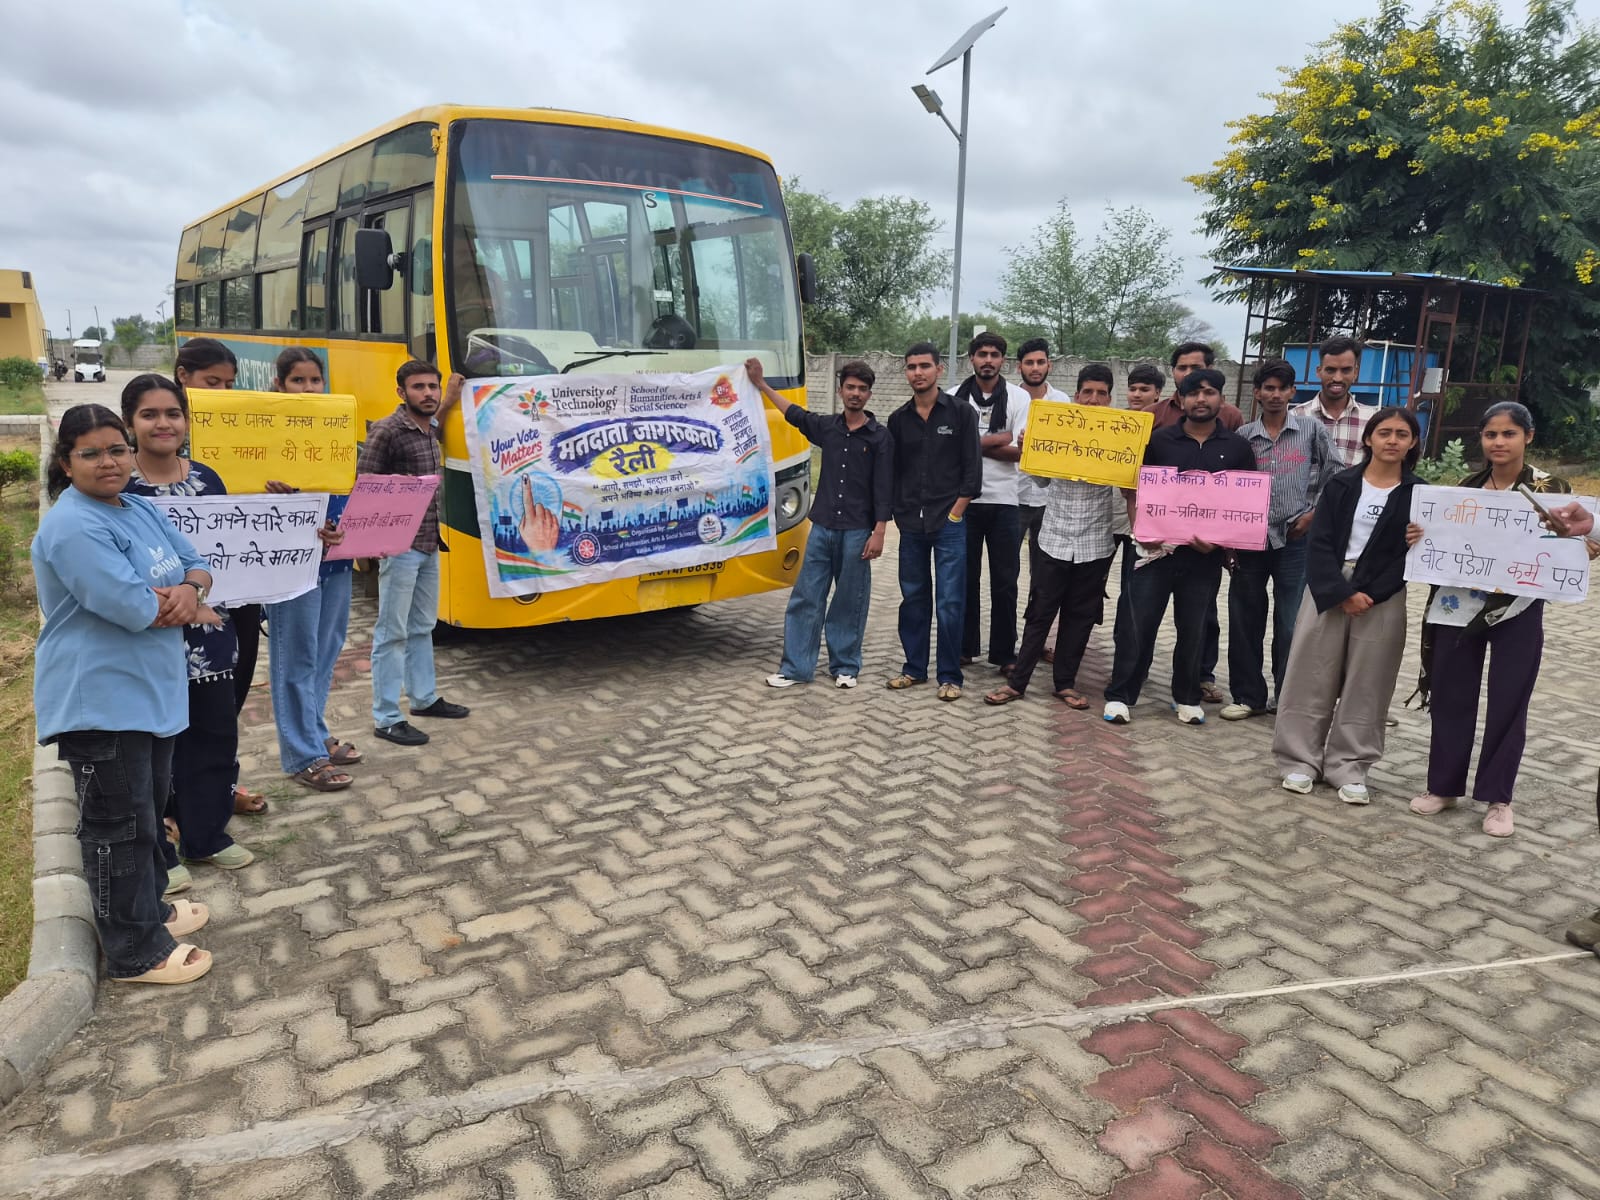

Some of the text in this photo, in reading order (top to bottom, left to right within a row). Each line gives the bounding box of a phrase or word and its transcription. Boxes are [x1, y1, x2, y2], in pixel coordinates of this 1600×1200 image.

[239, 358, 250, 389] OF
[552, 386, 618, 399] University of
[630, 386, 657, 394] School
[679, 392, 695, 400] Arts
[552, 397, 618, 411] Technology
[629, 403, 653, 413] Social
[192, 412, 214, 428] घर
[220, 413, 240, 427] घर
[1039, 413, 1054, 425] न
[1096, 420, 1108, 432] न
[491, 428, 540, 464] Your Vote
[558, 422, 628, 460] मतदाता
[200, 446, 222, 460] हर
[281, 440, 298, 462] को
[304, 440, 324, 462] वोट
[501, 441, 543, 470] Matters
[609, 444, 656, 475] रैली
[1140, 471, 1158, 485] क्या
[1235, 477, 1262, 488] शान
[207, 505, 250, 530] अपने
[251, 506, 287, 533] सारे
[1222, 509, 1264, 524] मतदान
[1421, 501, 1437, 522] न
[1443, 498, 1483, 526] जाति
[1485, 507, 1513, 529] पर
[269, 547, 315, 566] मतदान
[1420, 538, 1447, 571] वोट
[1507, 552, 1551, 582] कर्म
[1551, 567, 1585, 593] पर
